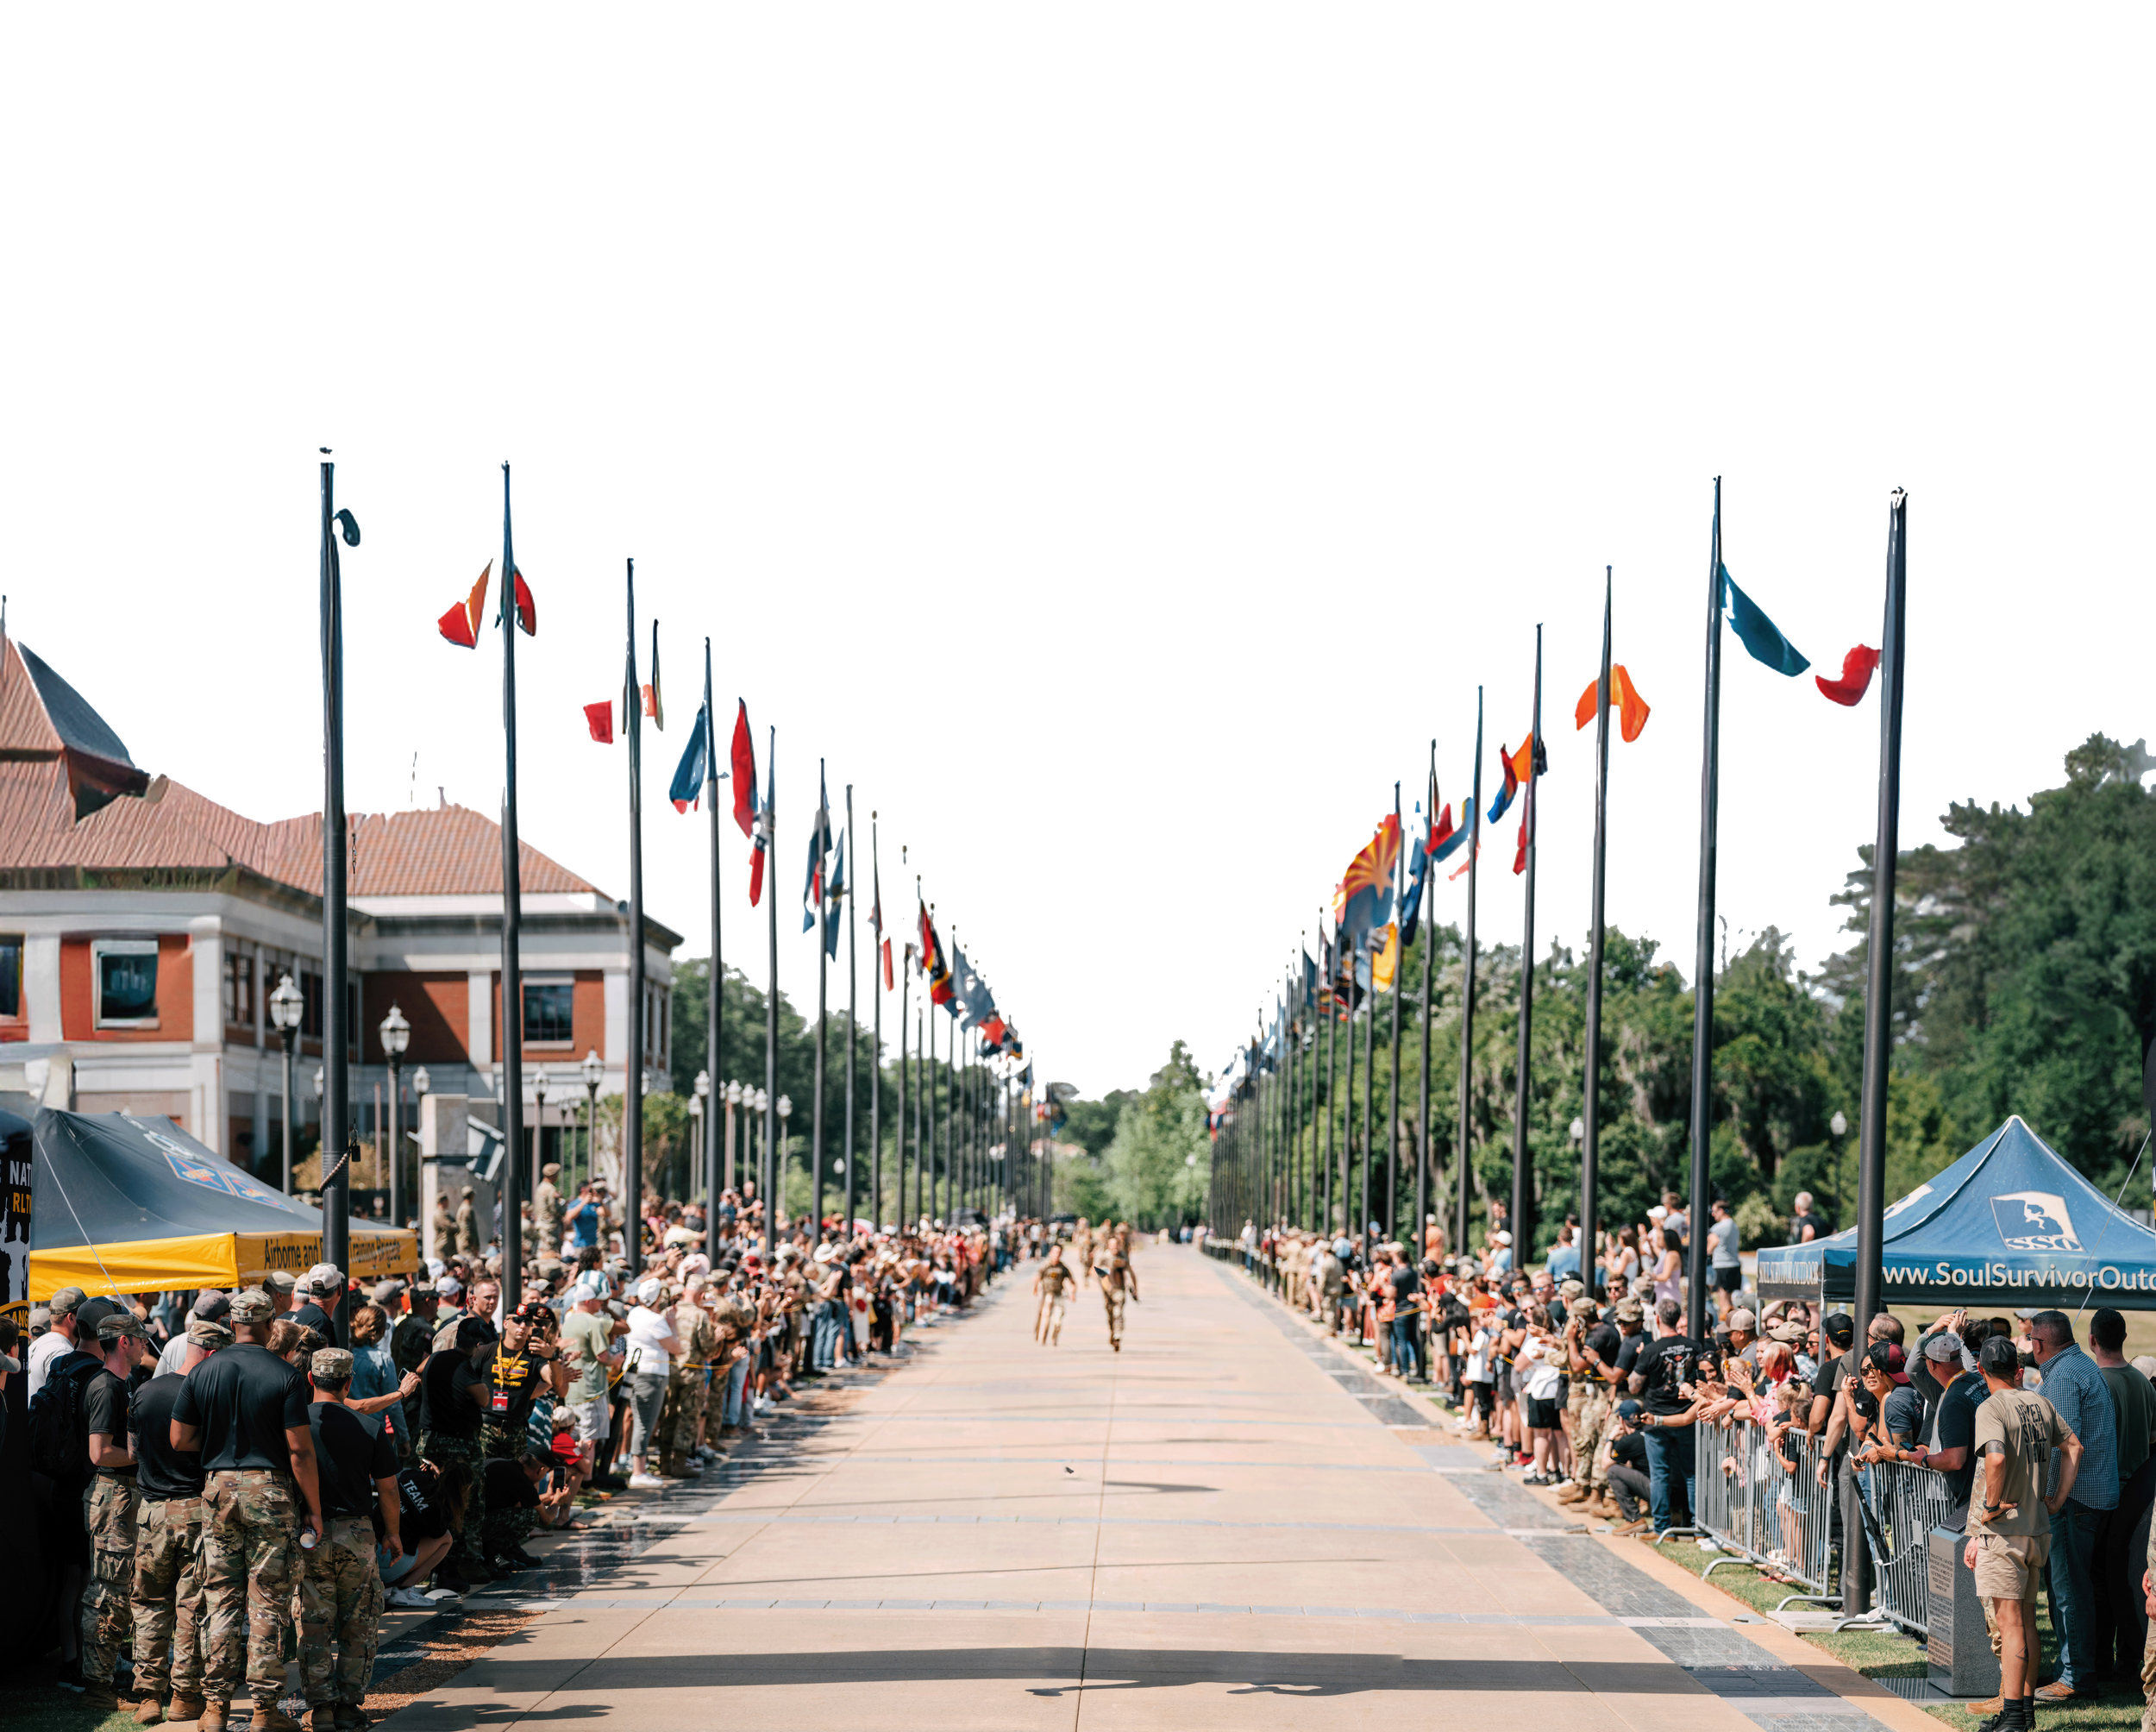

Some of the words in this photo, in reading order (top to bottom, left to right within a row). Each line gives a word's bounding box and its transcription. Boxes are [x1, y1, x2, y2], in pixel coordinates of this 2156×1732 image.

[264, 1238, 302, 1270] Airborne
[304, 1237, 319, 1266] and
[2008, 1236, 2080, 1251] SSO
[403, 1479, 429, 1511] TEAM
